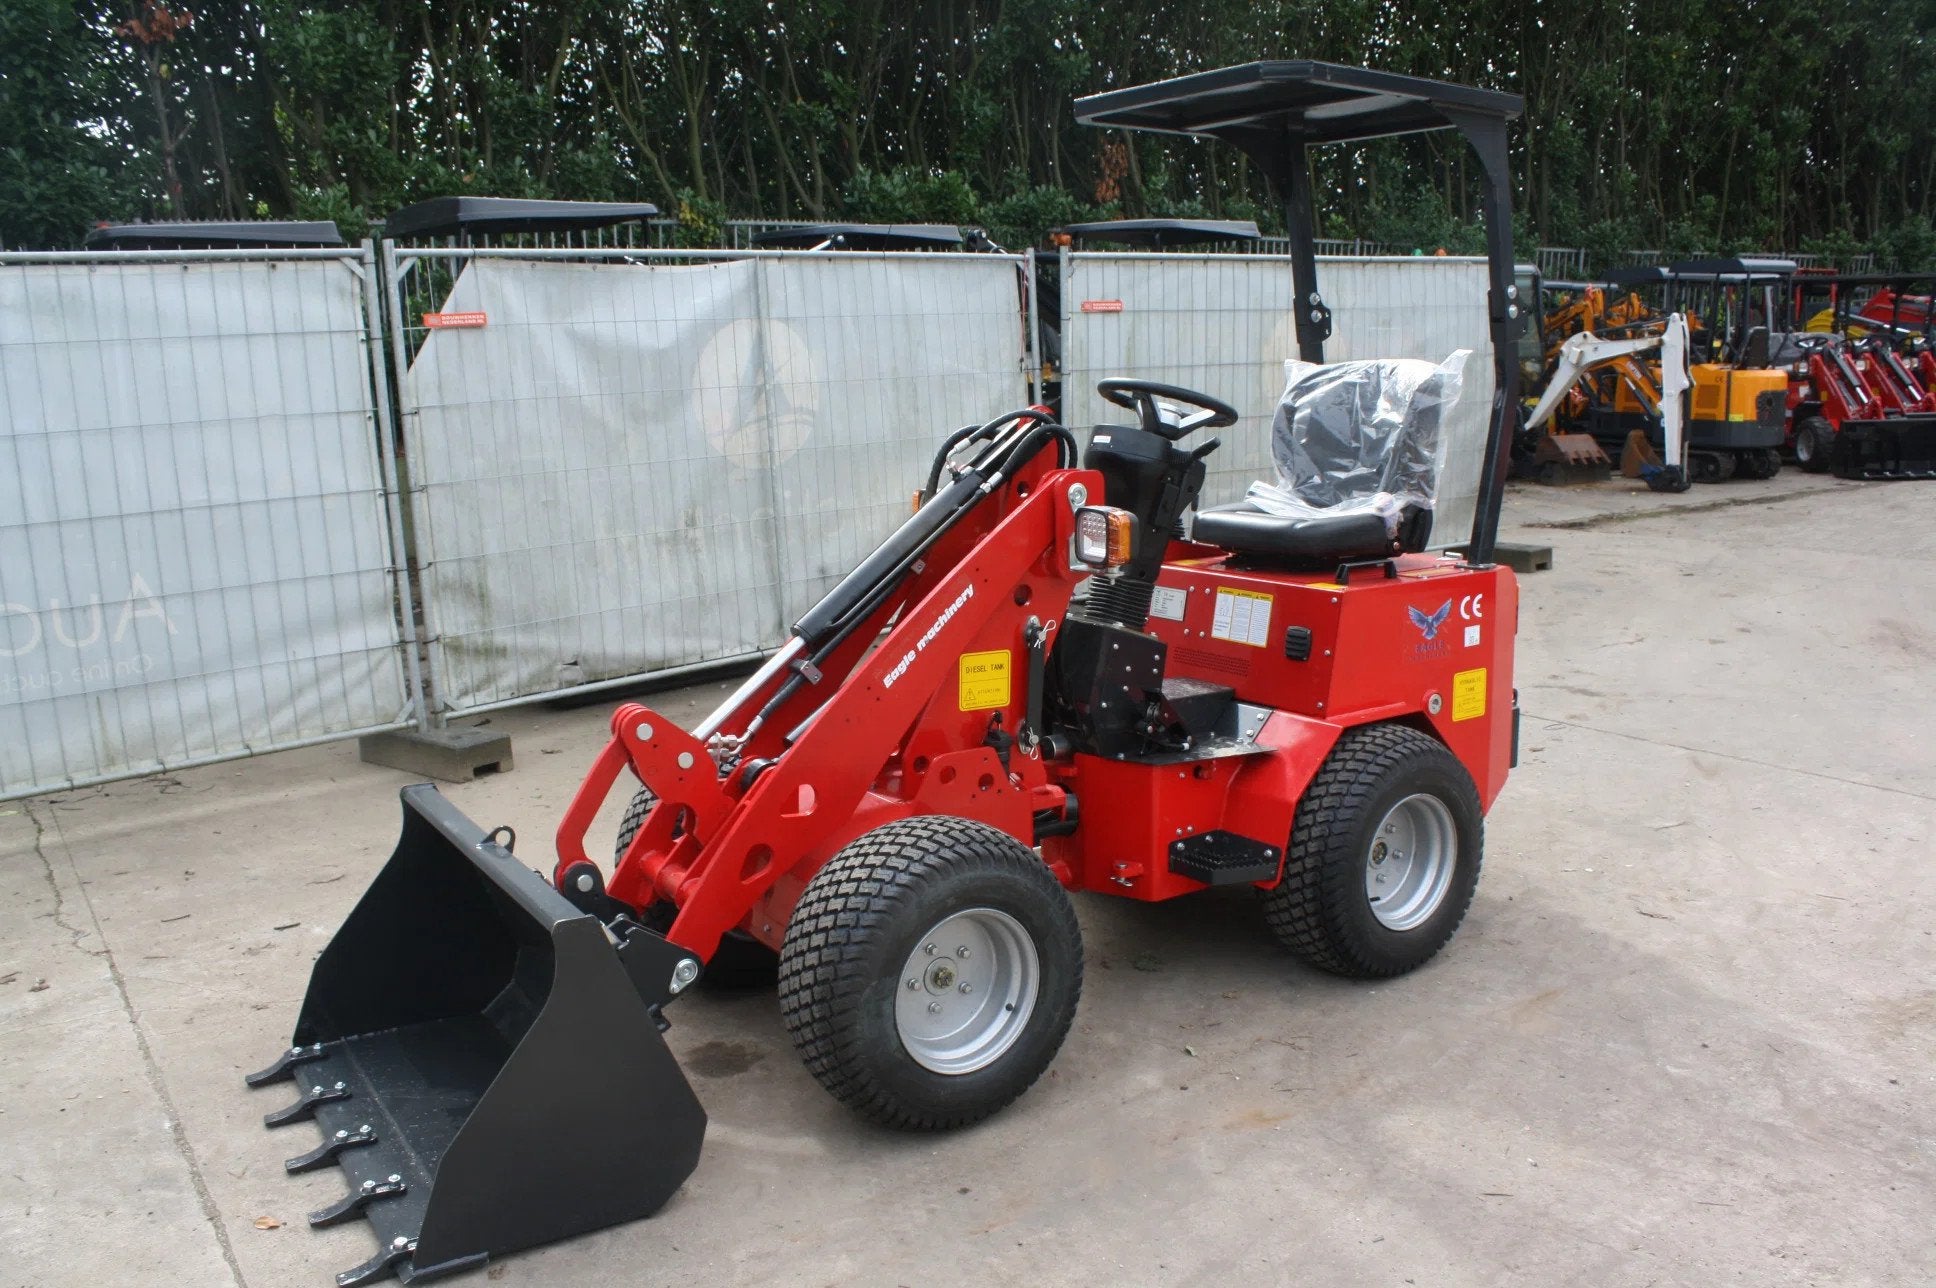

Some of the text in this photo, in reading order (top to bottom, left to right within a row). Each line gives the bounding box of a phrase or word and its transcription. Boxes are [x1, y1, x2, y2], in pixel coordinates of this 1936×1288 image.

[1460, 593, 1483, 620] CE
[882, 583, 975, 689] Eagle machinery
[965, 664, 988, 674] DIESEL
